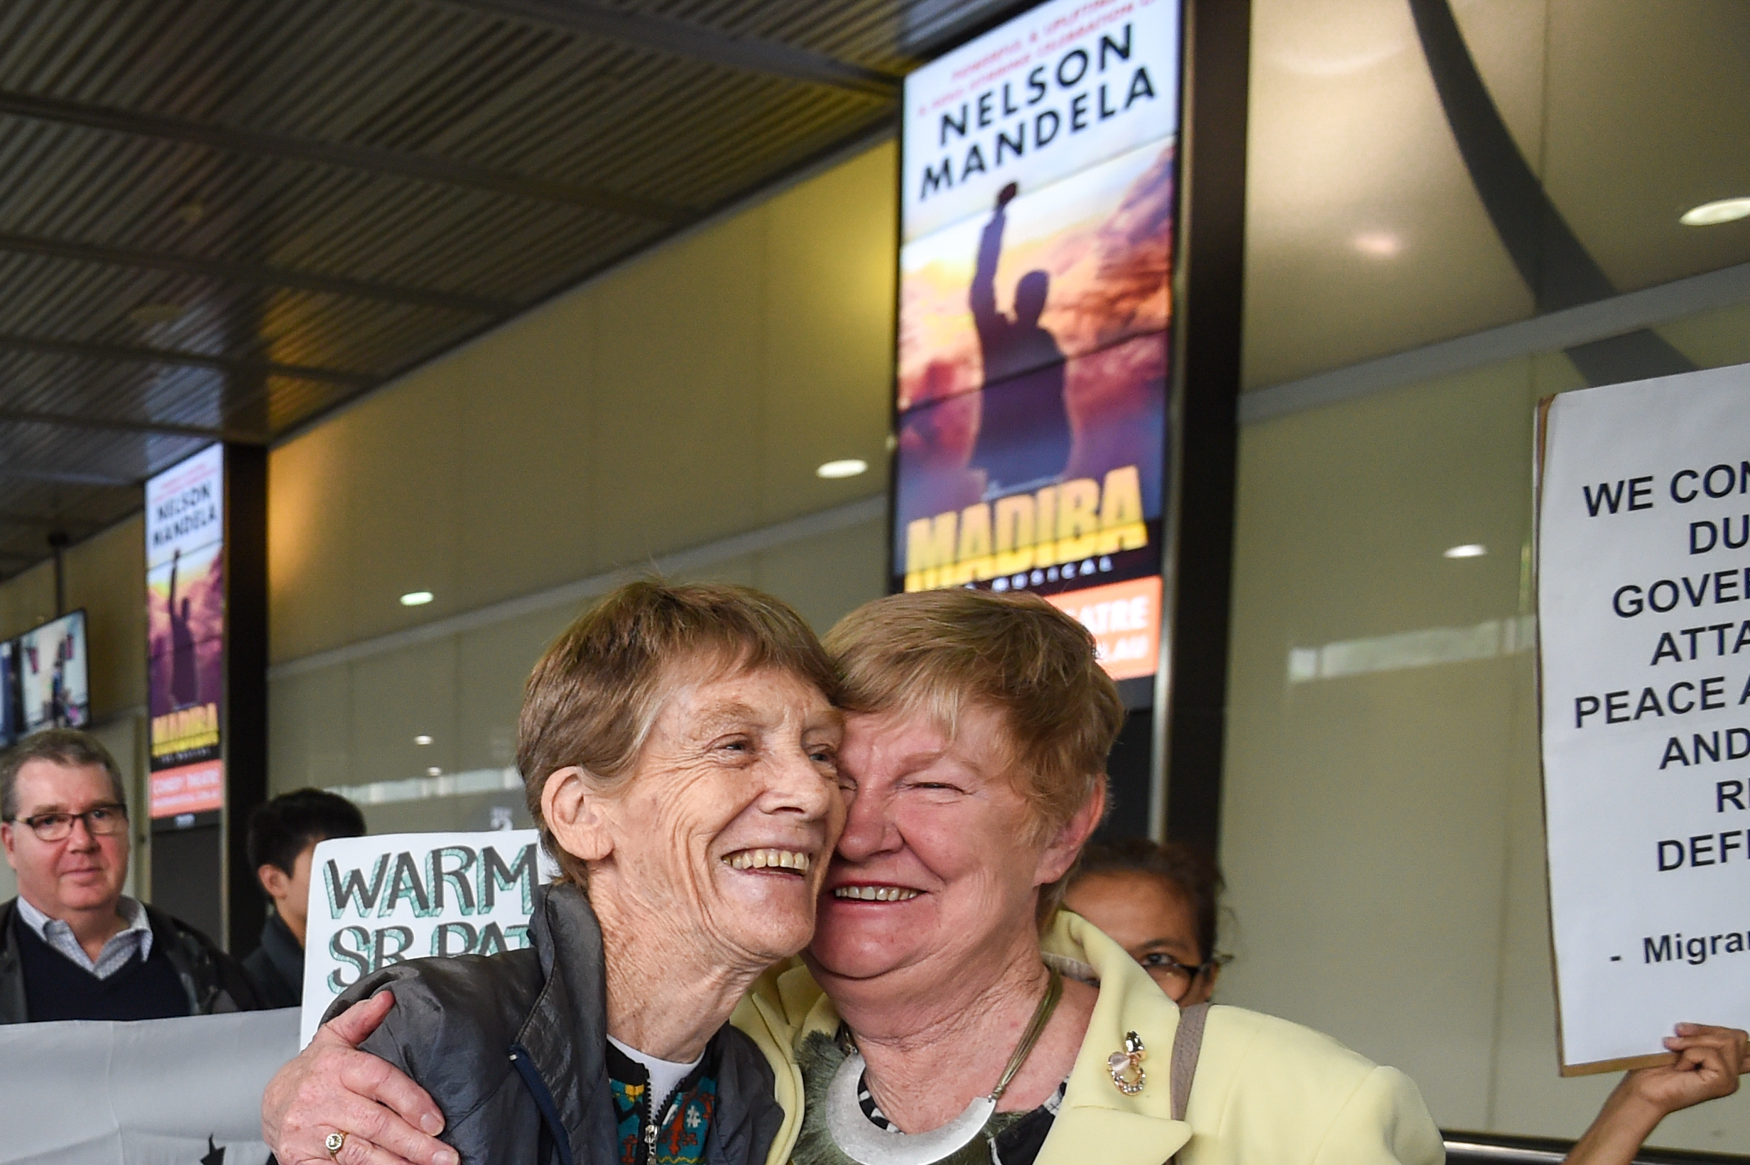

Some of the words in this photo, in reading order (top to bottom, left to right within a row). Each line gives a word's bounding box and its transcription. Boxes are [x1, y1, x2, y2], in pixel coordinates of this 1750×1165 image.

[939, 22, 1132, 147] NELSON
[920, 66, 1156, 201] MANDELA
[1583, 475, 1654, 518] WE
[904, 465, 1149, 593] MADIBA
[1689, 513, 1750, 556] DU
[991, 554, 1114, 593] MUSICAL
[1066, 594, 1149, 636] ATRE
[1574, 675, 1726, 729] PEACE
[1659, 727, 1750, 770] AND
[1716, 776, 1750, 814] R
[1657, 828, 1750, 873] DEF
[323, 842, 541, 919] WARM
[1643, 930, 1750, 966] Migra
